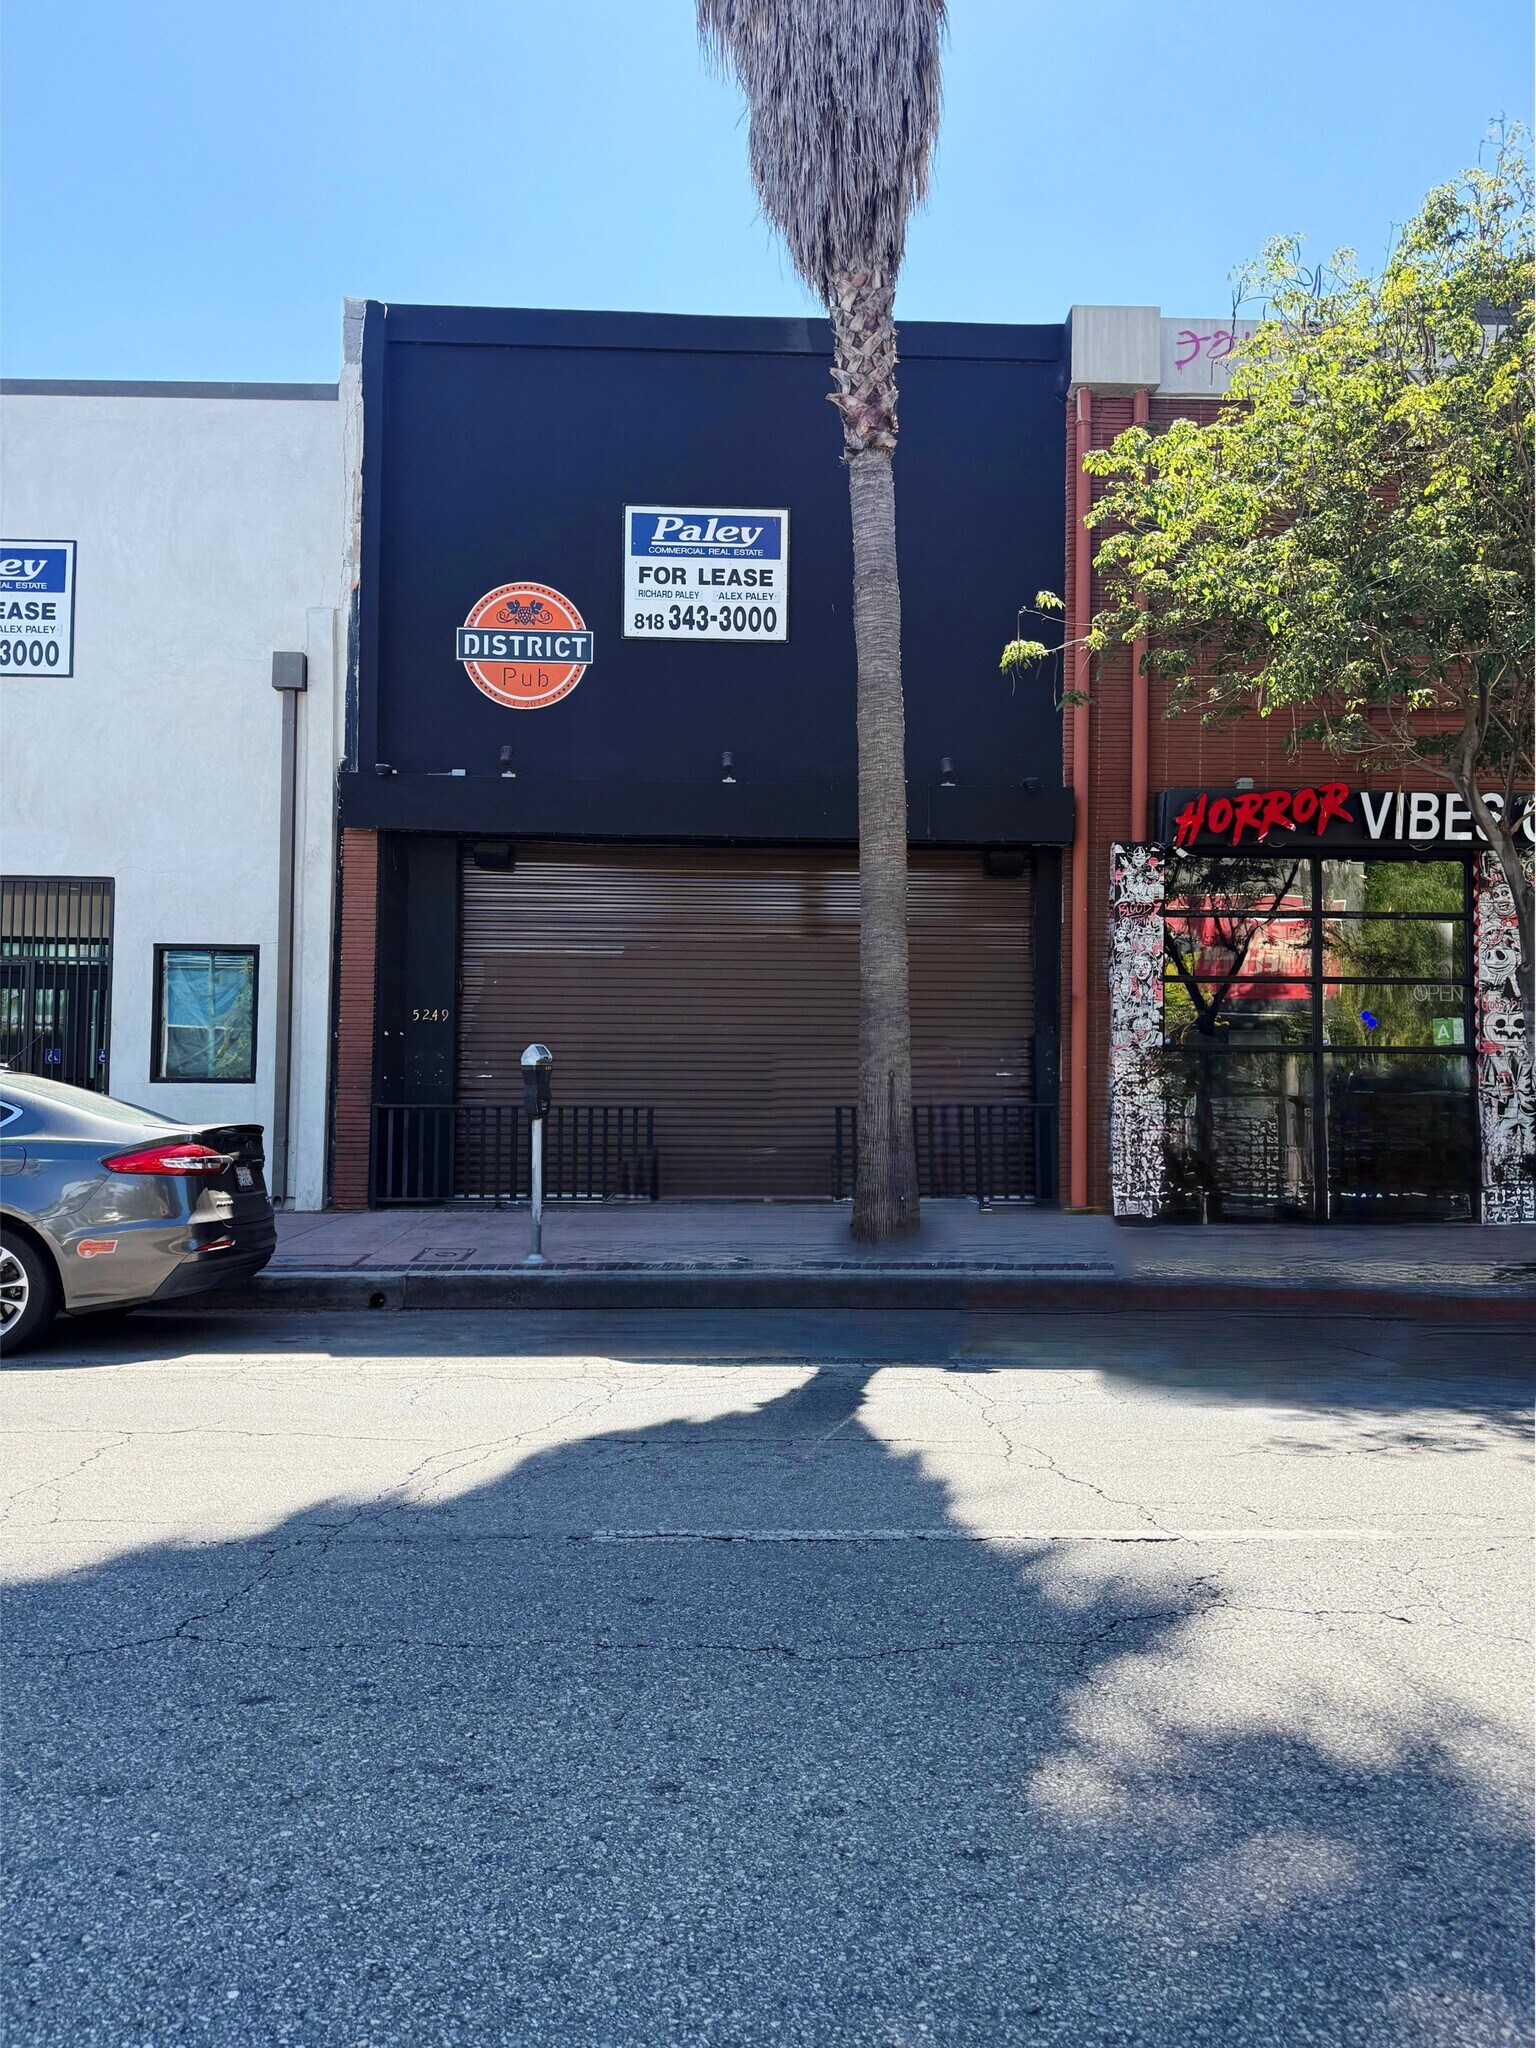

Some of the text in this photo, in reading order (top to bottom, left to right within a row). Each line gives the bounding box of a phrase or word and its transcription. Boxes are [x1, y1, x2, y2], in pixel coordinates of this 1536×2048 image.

[651, 516, 763, 548] Paley
[648, 547, 764, 557] COMMERCIAL REAL ESTATE
[638, 566, 774, 587] FOR LEASE
[638, 589, 774, 600] RICHARD PALEY ALEX PALEY
[634, 605, 777, 632] 818 343-3000
[25, 626, 56, 634] PALEY
[464, 634, 587, 658] DISTRICT
[503, 667, 549, 687] Pub
[1175, 782, 1354, 847] HORROR
[1360, 792, 1505, 841] VIBES
[1413, 984, 1464, 1001] OPEN
[412, 1008, 449, 1022] 5249
[1438, 1025, 1450, 1039] A
